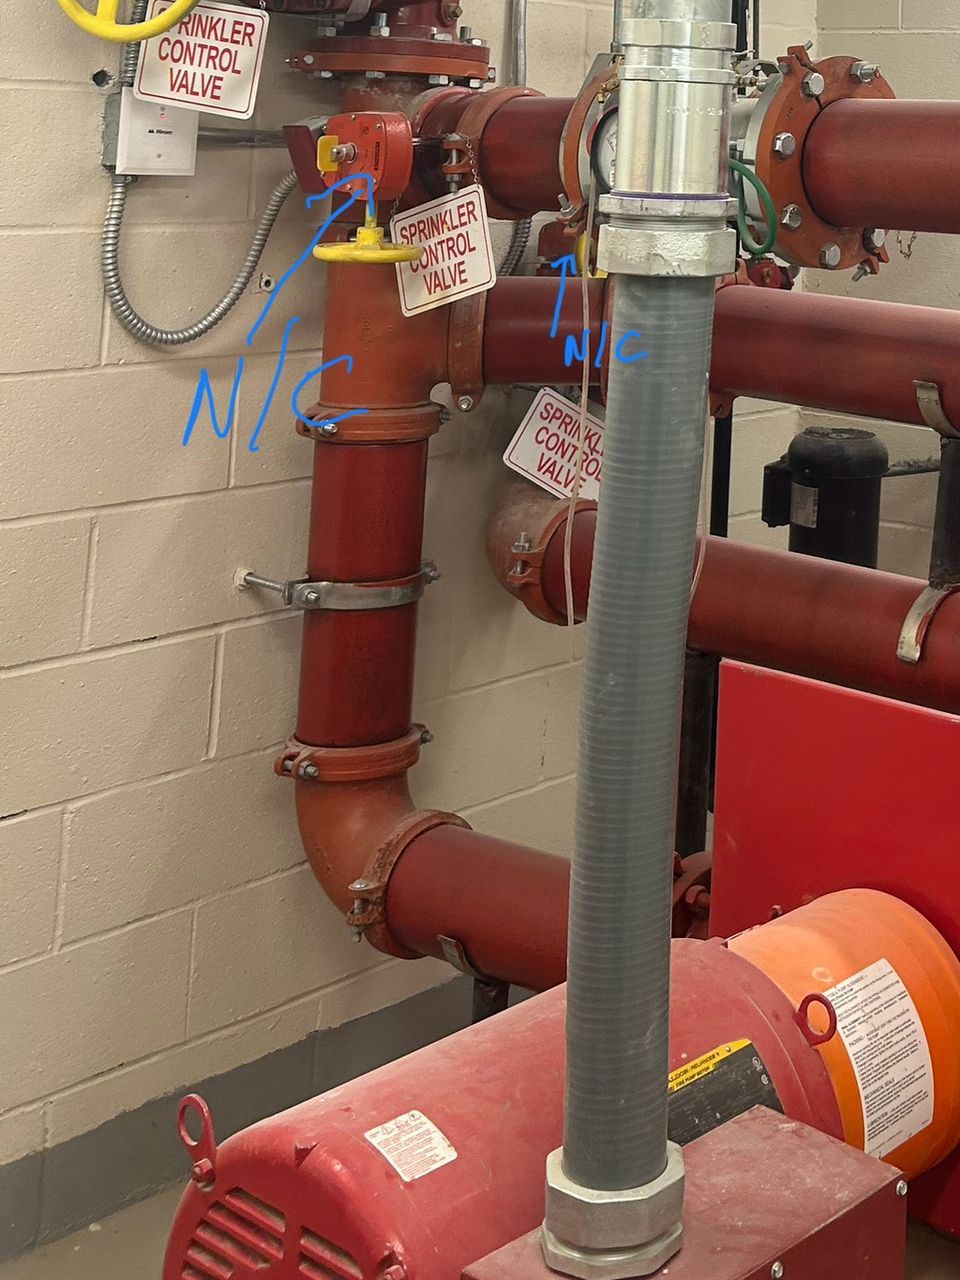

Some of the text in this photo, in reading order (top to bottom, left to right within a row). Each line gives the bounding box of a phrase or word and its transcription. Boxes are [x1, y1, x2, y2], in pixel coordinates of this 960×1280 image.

[158, 7, 256, 48] RINKLER
[158, 37, 242, 75] CONTROL
[169, 67, 224, 100] VALVE
[400, 199, 479, 245] SPRINKLER
[423, 260, 469, 296] VALVE
